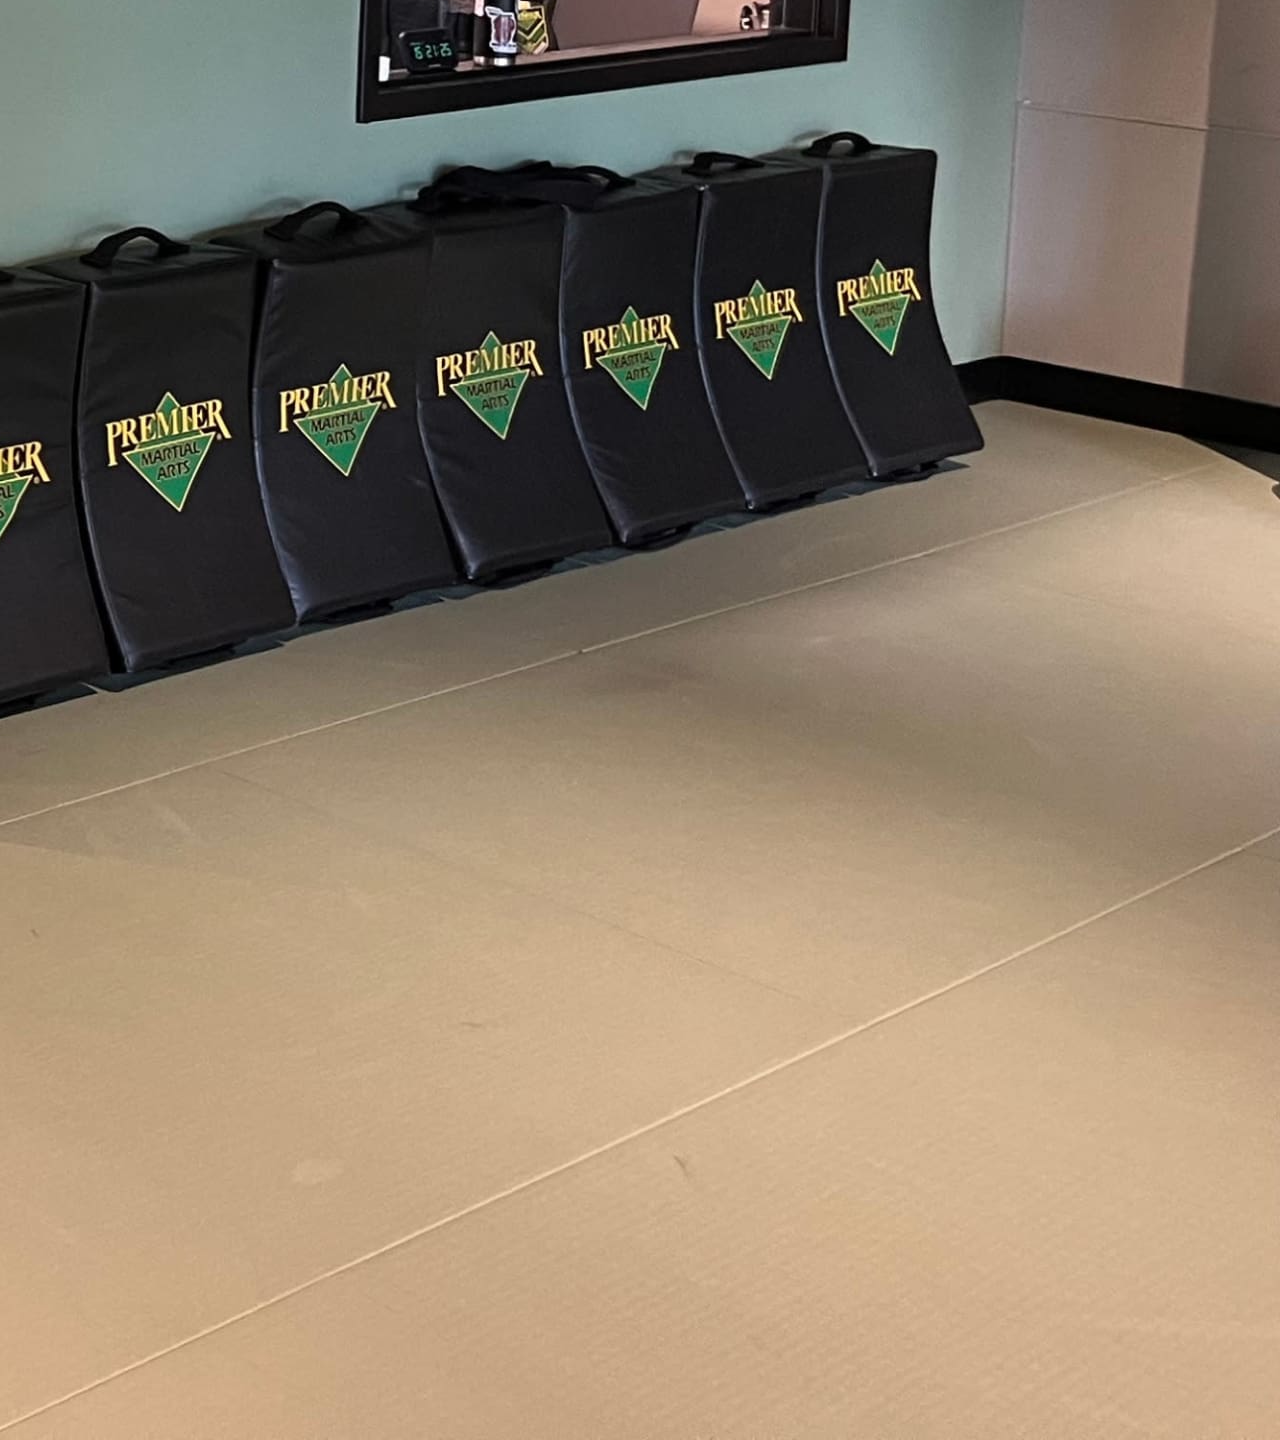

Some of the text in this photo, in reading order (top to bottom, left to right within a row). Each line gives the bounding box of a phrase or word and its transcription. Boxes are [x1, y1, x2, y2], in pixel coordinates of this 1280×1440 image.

[836, 266, 922, 318] PREMIER
[713, 287, 804, 340] PREMIER
[581, 313, 680, 370] PREMIER
[435, 338, 545, 397] PREMIER
[610, 350, 657, 370] MARTIAL
[624, 366, 653, 383] ARTS
[466, 377, 518, 398] MARTIAL
[278, 370, 398, 434] PREMIER
[481, 394, 511, 412] ARTS
[105, 398, 233, 467] PREMIER
[309, 410, 367, 434] MARTIAL
[325, 427, 357, 448] ARTS
[140, 442, 201, 467] MARTIAL
[156, 460, 191, 482] ARTS
